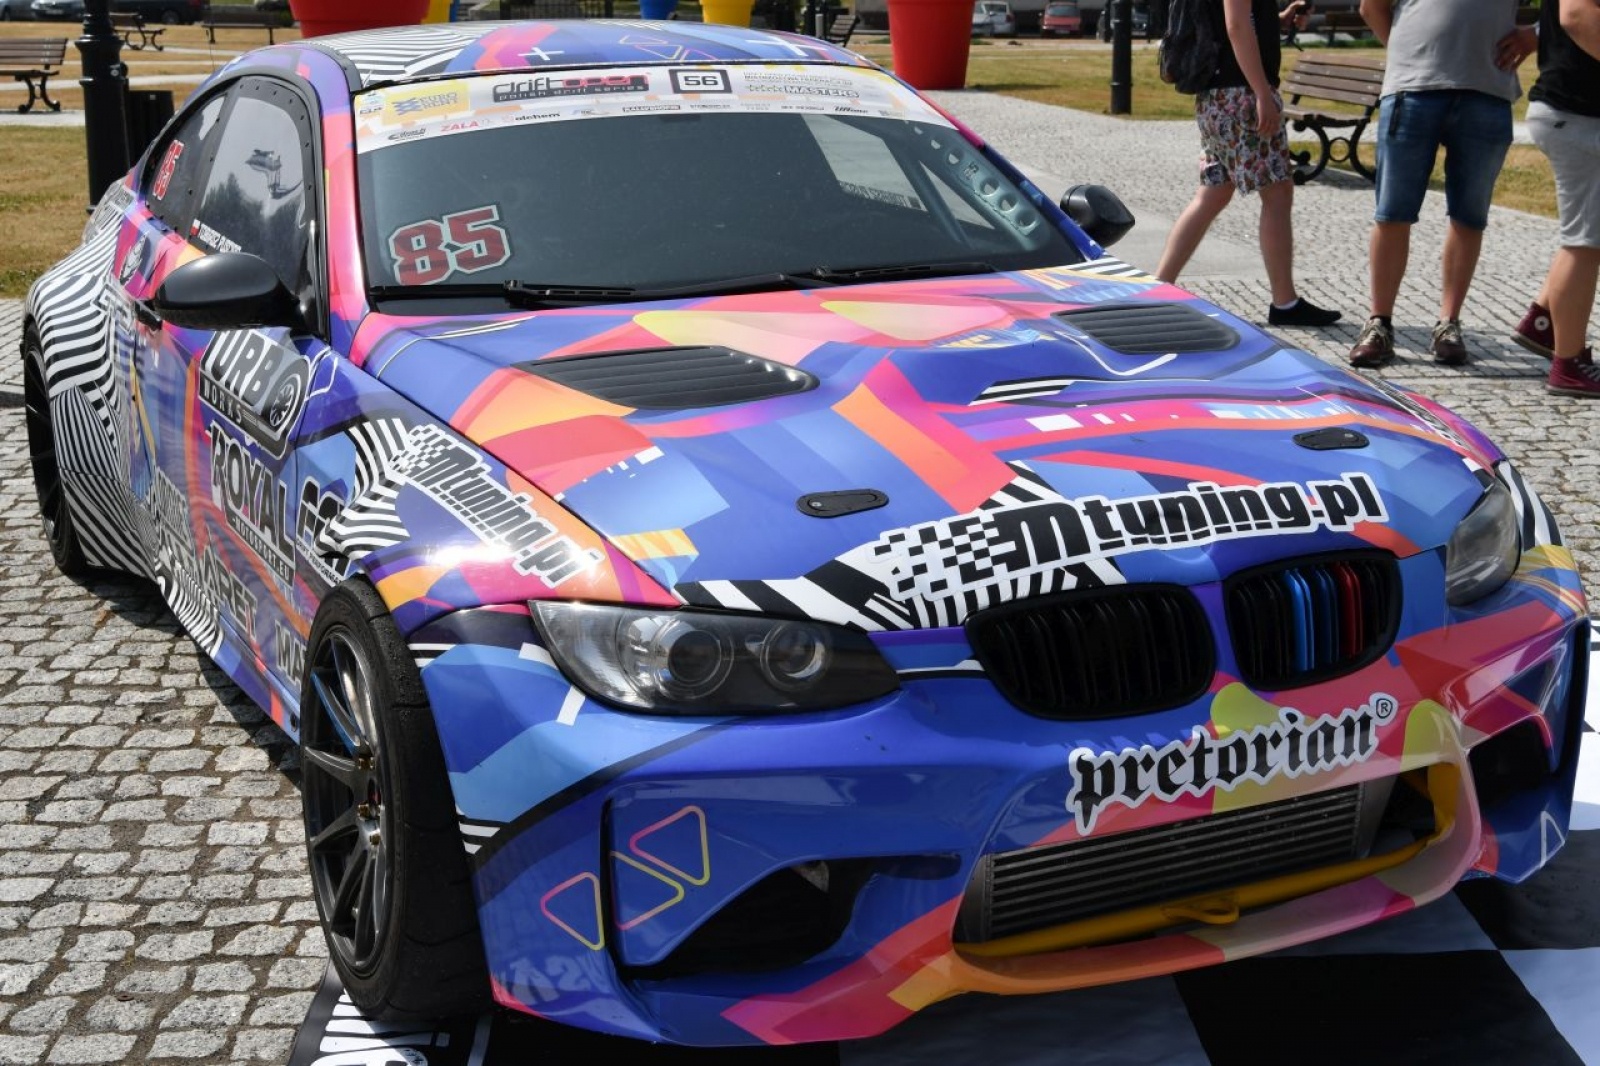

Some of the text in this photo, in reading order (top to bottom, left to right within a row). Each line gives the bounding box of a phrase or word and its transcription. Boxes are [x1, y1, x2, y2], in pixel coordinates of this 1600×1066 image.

[684, 75, 719, 87] 56
[440, 120, 480, 133] ZALA
[388, 204, 511, 286] 85
[203, 380, 243, 425] WORKS
[210, 421, 296, 567] ROYAL
